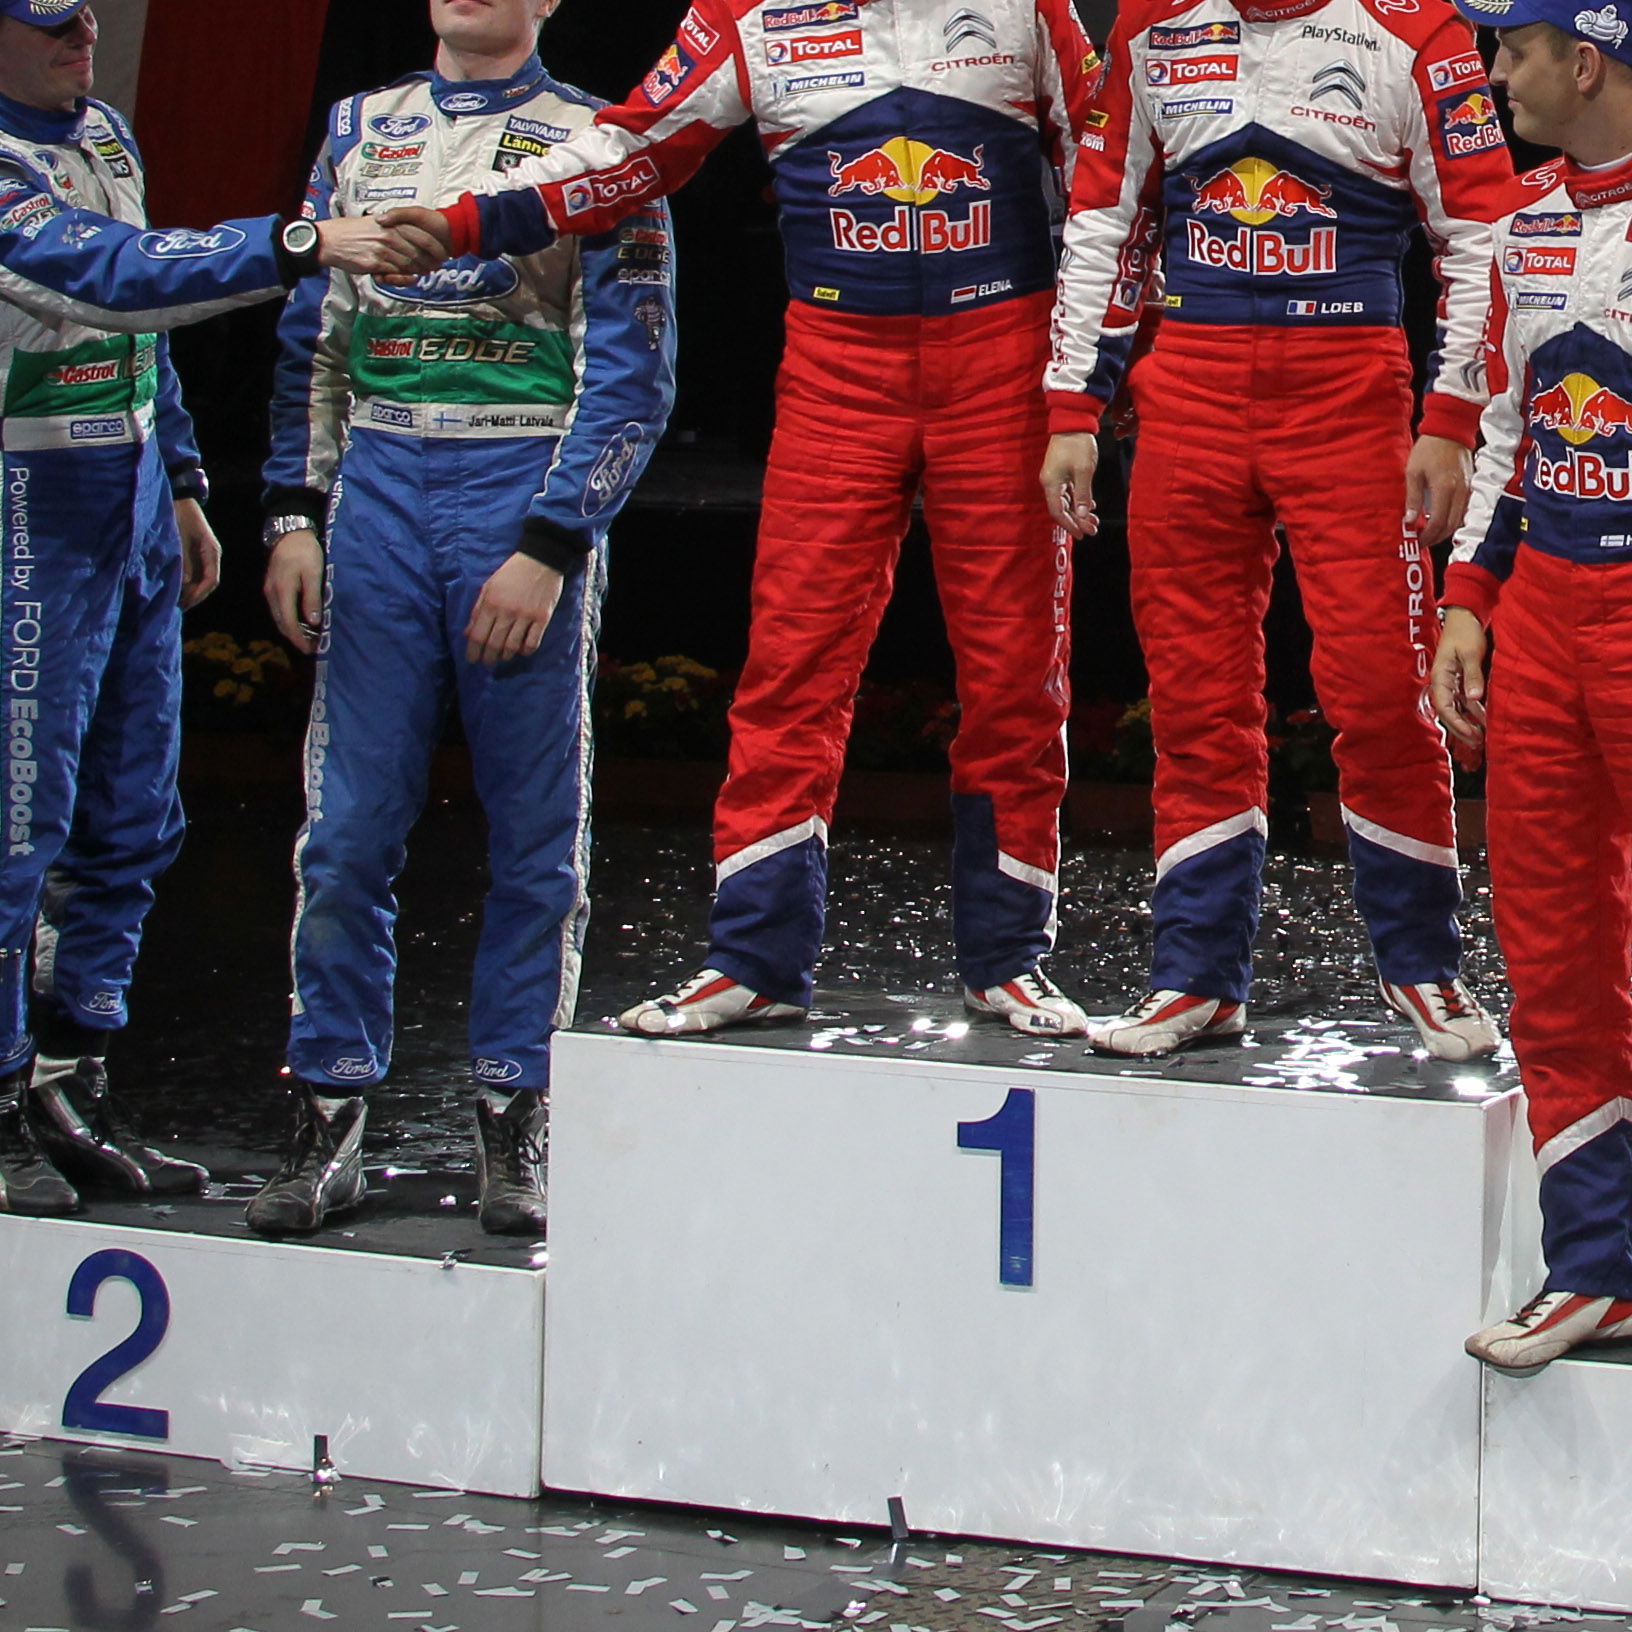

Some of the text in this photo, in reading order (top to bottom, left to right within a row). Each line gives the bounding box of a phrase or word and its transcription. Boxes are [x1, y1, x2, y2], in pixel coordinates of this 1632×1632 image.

[793, 38, 860, 57] TOTAL
[1301, 24, 1377, 52] PlayStation
[1173, 61, 1233, 79] TOTAL
[790, 74, 861, 92] MICHELIN
[444, 96, 481, 109] Ford
[1165, 99, 1231, 114] MICHELIN
[380, 118, 420, 136] Ford
[509, 118, 568, 141] TALVIVAARA
[377, 146, 420, 159] Castrol
[597, 169, 657, 198] TOTAL
[12, 196, 52, 222] Castrol
[156, 230, 220, 252] Ford
[1525, 253, 1571, 269] TOTAL
[414, 263, 486, 291] ord
[979, 280, 1013, 297] ELENA
[1321, 302, 1364, 314] LOEB
[1518, 294, 1564, 306] MICHELIN
[418, 337, 537, 364] EDGE
[63, 363, 117, 384] Castrol
[72, 420, 124, 436] sparco
[590, 438, 634, 501] Ford
[9, 468, 42, 856] Powered by FORD EcoBoost
[332, 1058, 372, 1075] Ford
[475, 1058, 509, 1079] Ford
[957, 1087, 1037, 1287] 1
[62, 1248, 170, 1440] 2
